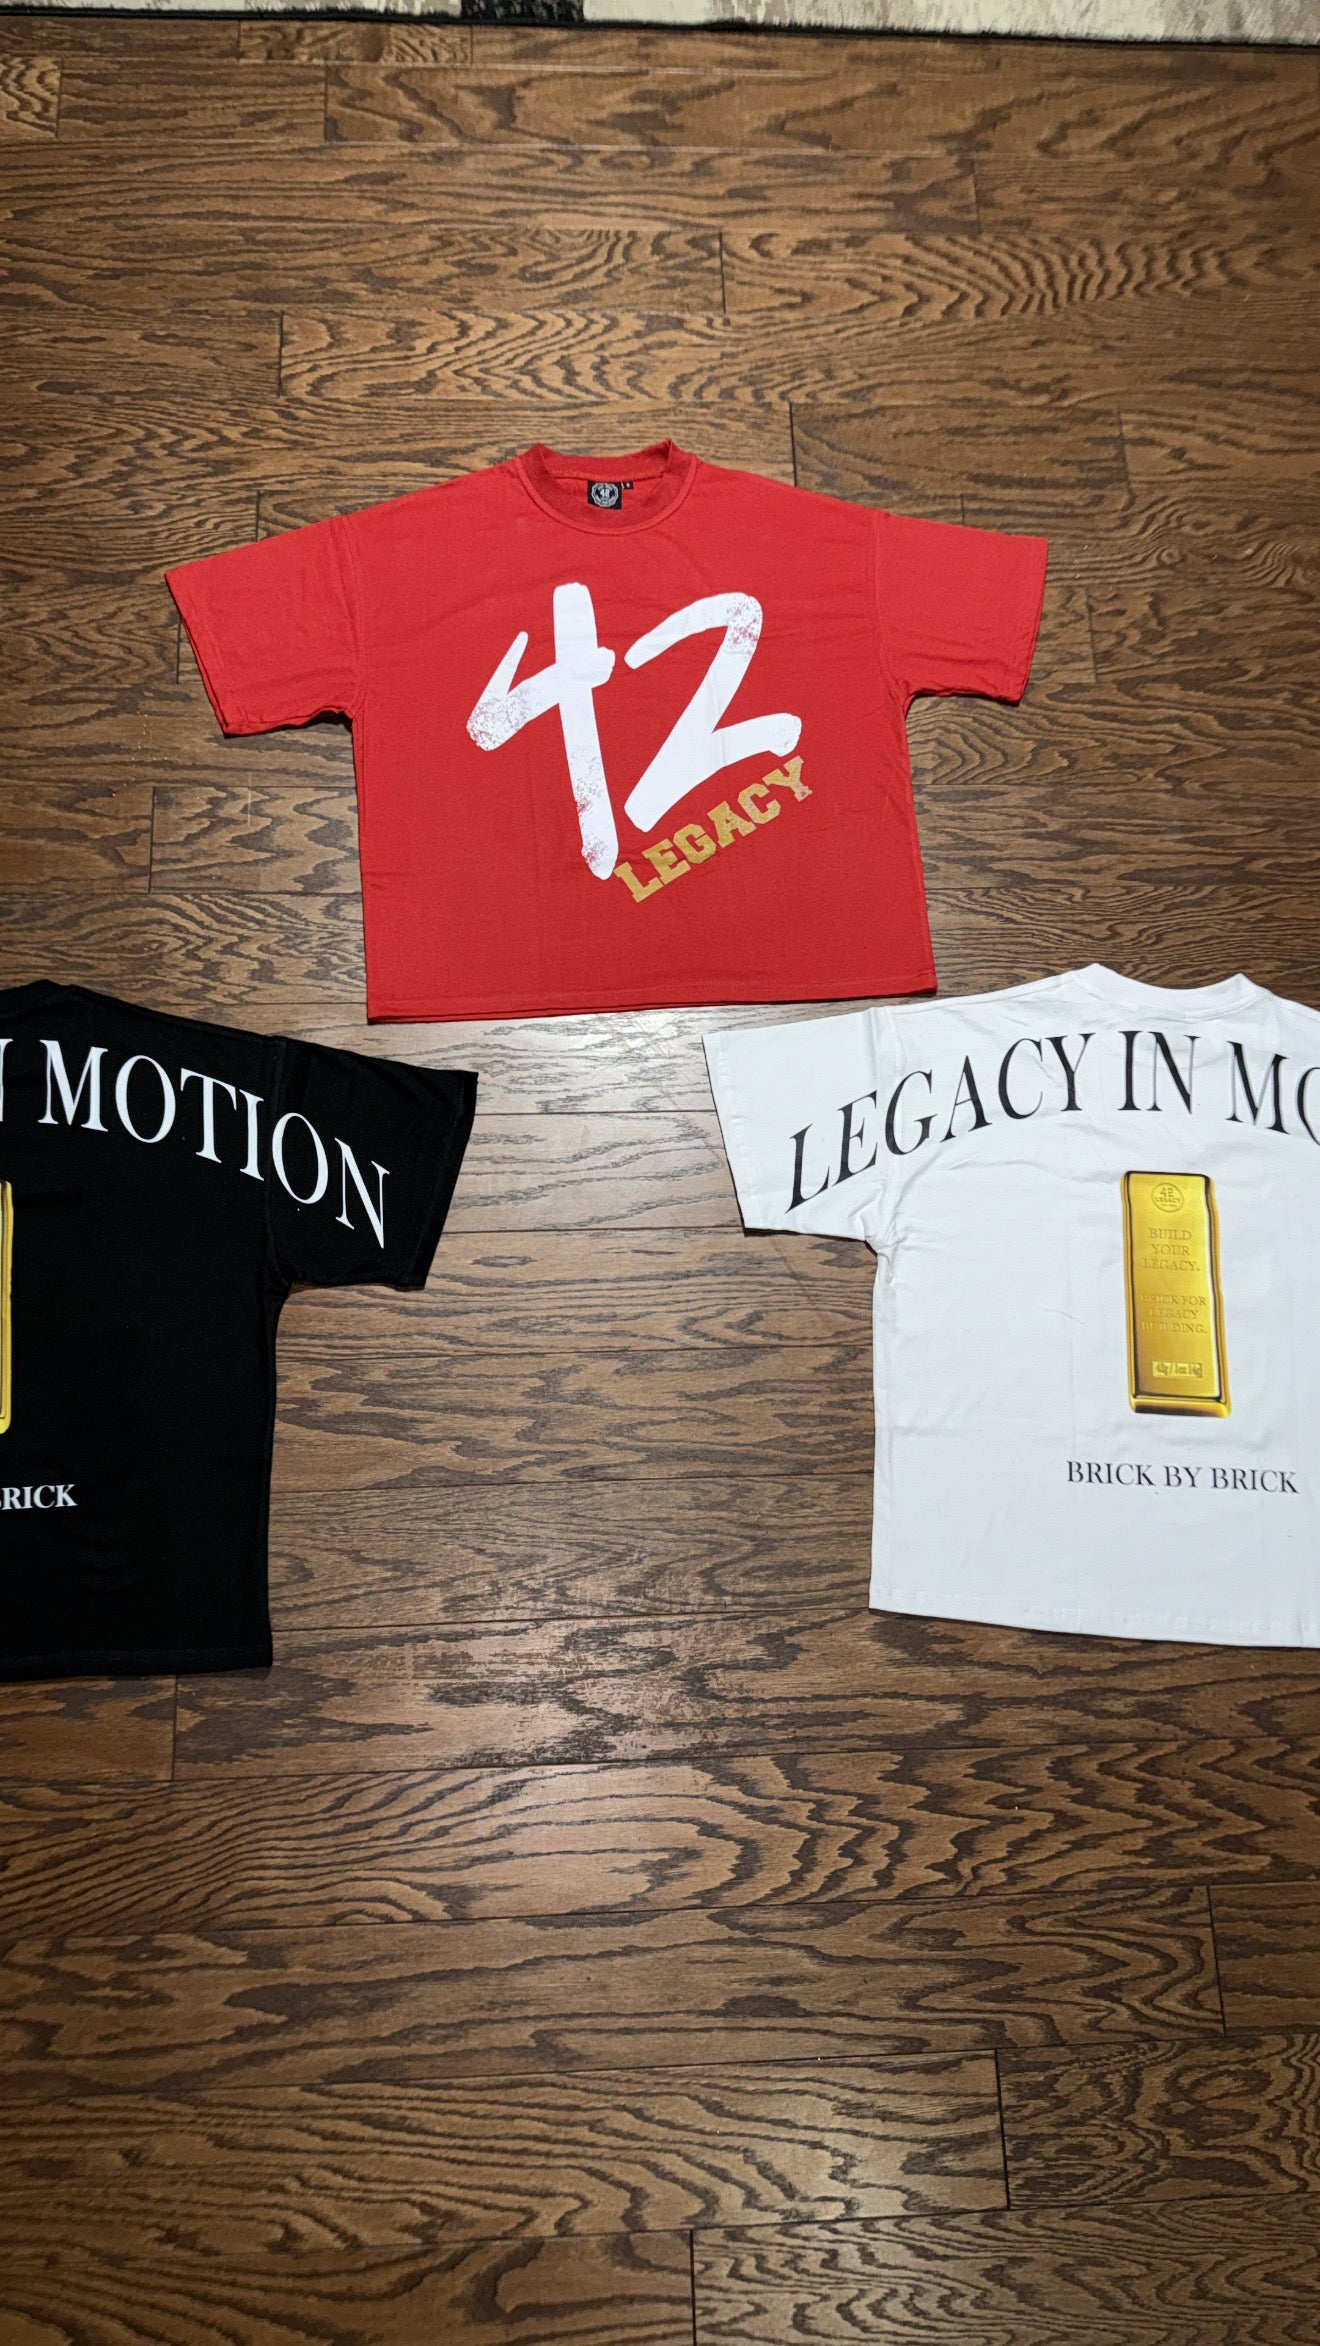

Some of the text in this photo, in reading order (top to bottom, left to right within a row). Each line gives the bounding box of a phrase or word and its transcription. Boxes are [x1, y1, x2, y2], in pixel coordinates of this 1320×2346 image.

[466, 581, 802, 880] 42
[613, 755, 813, 903] LEGACY
[785, 1032, 1096, 1214] LEGACY
[1117, 1030, 1200, 1114] IN
[37, 1039, 390, 1249] MOTION
[1148, 1227, 1192, 1240] BUILD
[1141, 1258, 1200, 1271] LEGACY.
[1151, 1243, 1190, 1256] YOUR
[1180, 1295, 1207, 1306] FOR
[1066, 1460, 1300, 1494] BRICK BY BRICK
[0, 1484, 78, 1510] RICK
